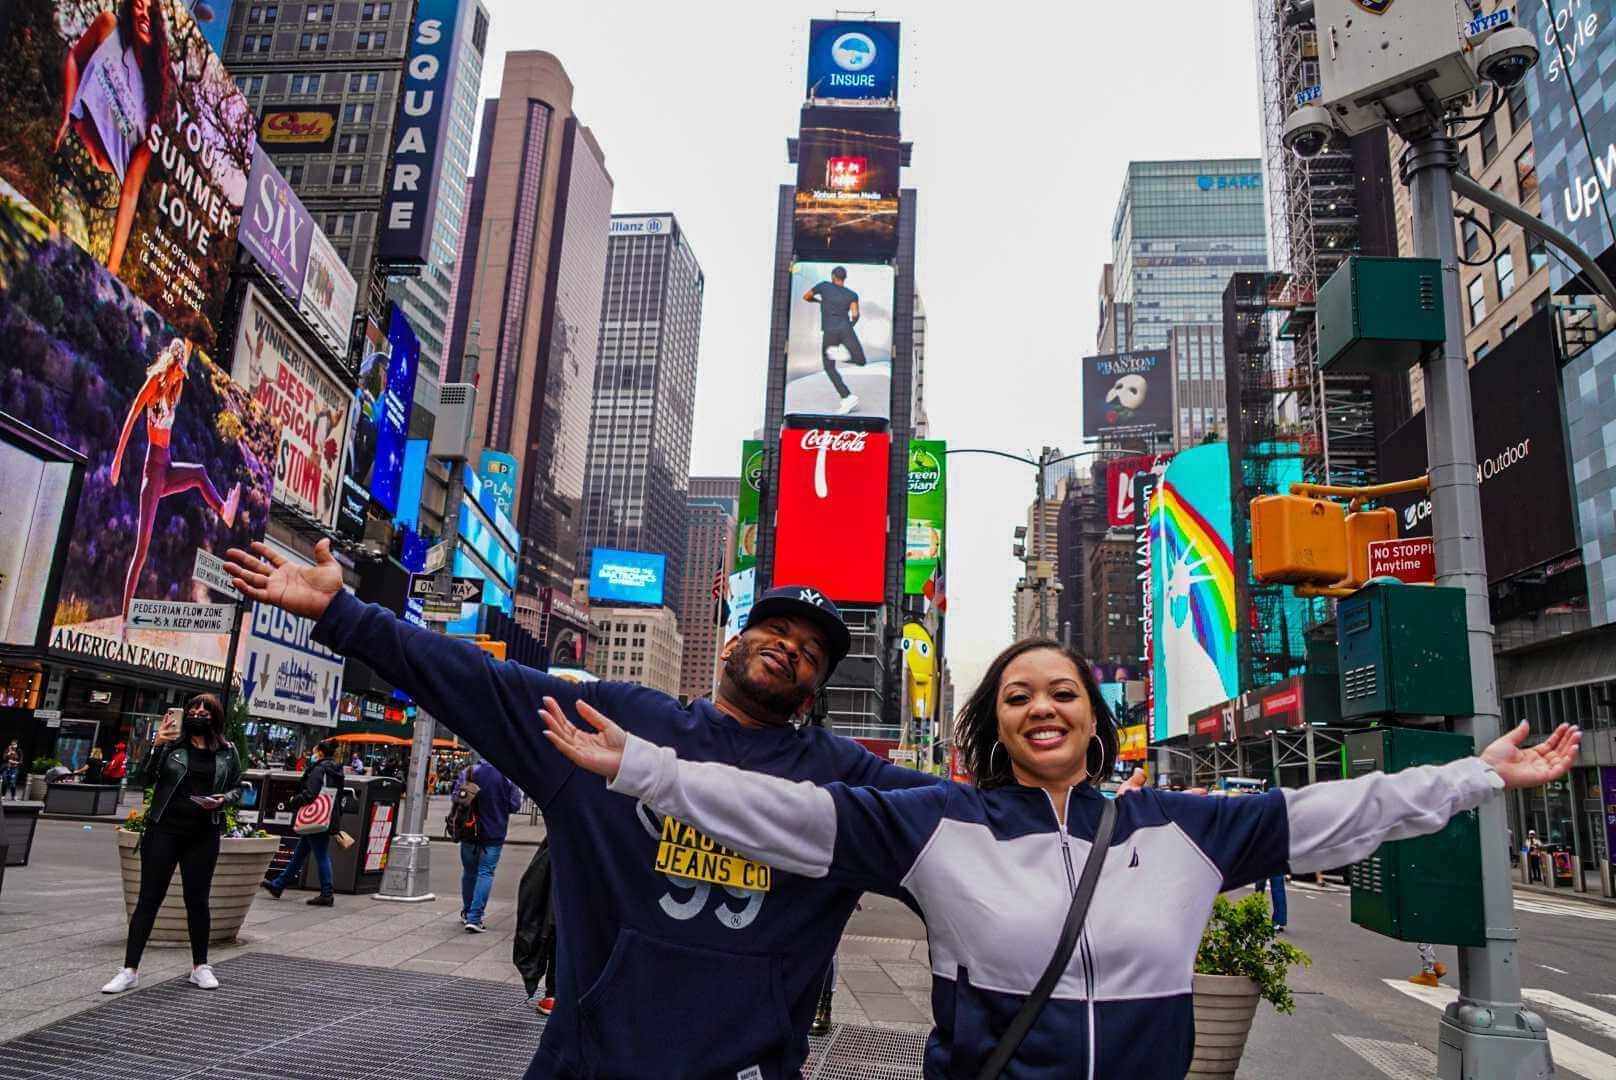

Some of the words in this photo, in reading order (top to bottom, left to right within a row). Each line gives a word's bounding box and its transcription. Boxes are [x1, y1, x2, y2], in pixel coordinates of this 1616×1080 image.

[1470, 9, 1509, 35] NYPD
[1548, 13, 1598, 82] style
[829, 73, 876, 87] INSURE
[1296, 86, 1321, 105] NYP
[388, 20, 441, 229] SQUARE
[175, 100, 225, 181] YOUR
[147, 122, 232, 237] SUMMER
[158, 182, 210, 256] LOVE
[253, 173, 305, 273] SIX
[608, 221, 644, 232] llianz
[171, 243, 201, 278] OFFLINE
[1097, 356, 1156, 371] PHANTOM
[277, 361, 313, 415] BEST
[257, 376, 319, 453] MUSICAL
[1483, 438, 1530, 479] Outdoor
[908, 471, 938, 479] reen
[484, 480, 512, 498] PLAY
[1417, 500, 1432, 519] Cle
[1374, 547, 1390, 559] NO
[1392, 543, 1434, 558] STOPPI
[1376, 560, 1421, 573] Anytime
[420, 582, 434, 593] ON
[448, 583, 472, 596] WAY
[799, 589, 824, 606] NY
[133, 603, 180, 616] PEDESTRIAN
[183, 606, 203, 616] FLOW
[204, 607, 223, 617] ZONE
[173, 617, 193, 629] KEEP
[194, 619, 222, 629] MOVING
[53, 627, 136, 666] AMERICAN
[140, 647, 179, 675] EAGLE
[180, 658, 242, 688] OUTFITTRS
[254, 697, 268, 708] Sports
[656, 844, 732, 882] JEANS
[742, 862, 769, 888] CO
